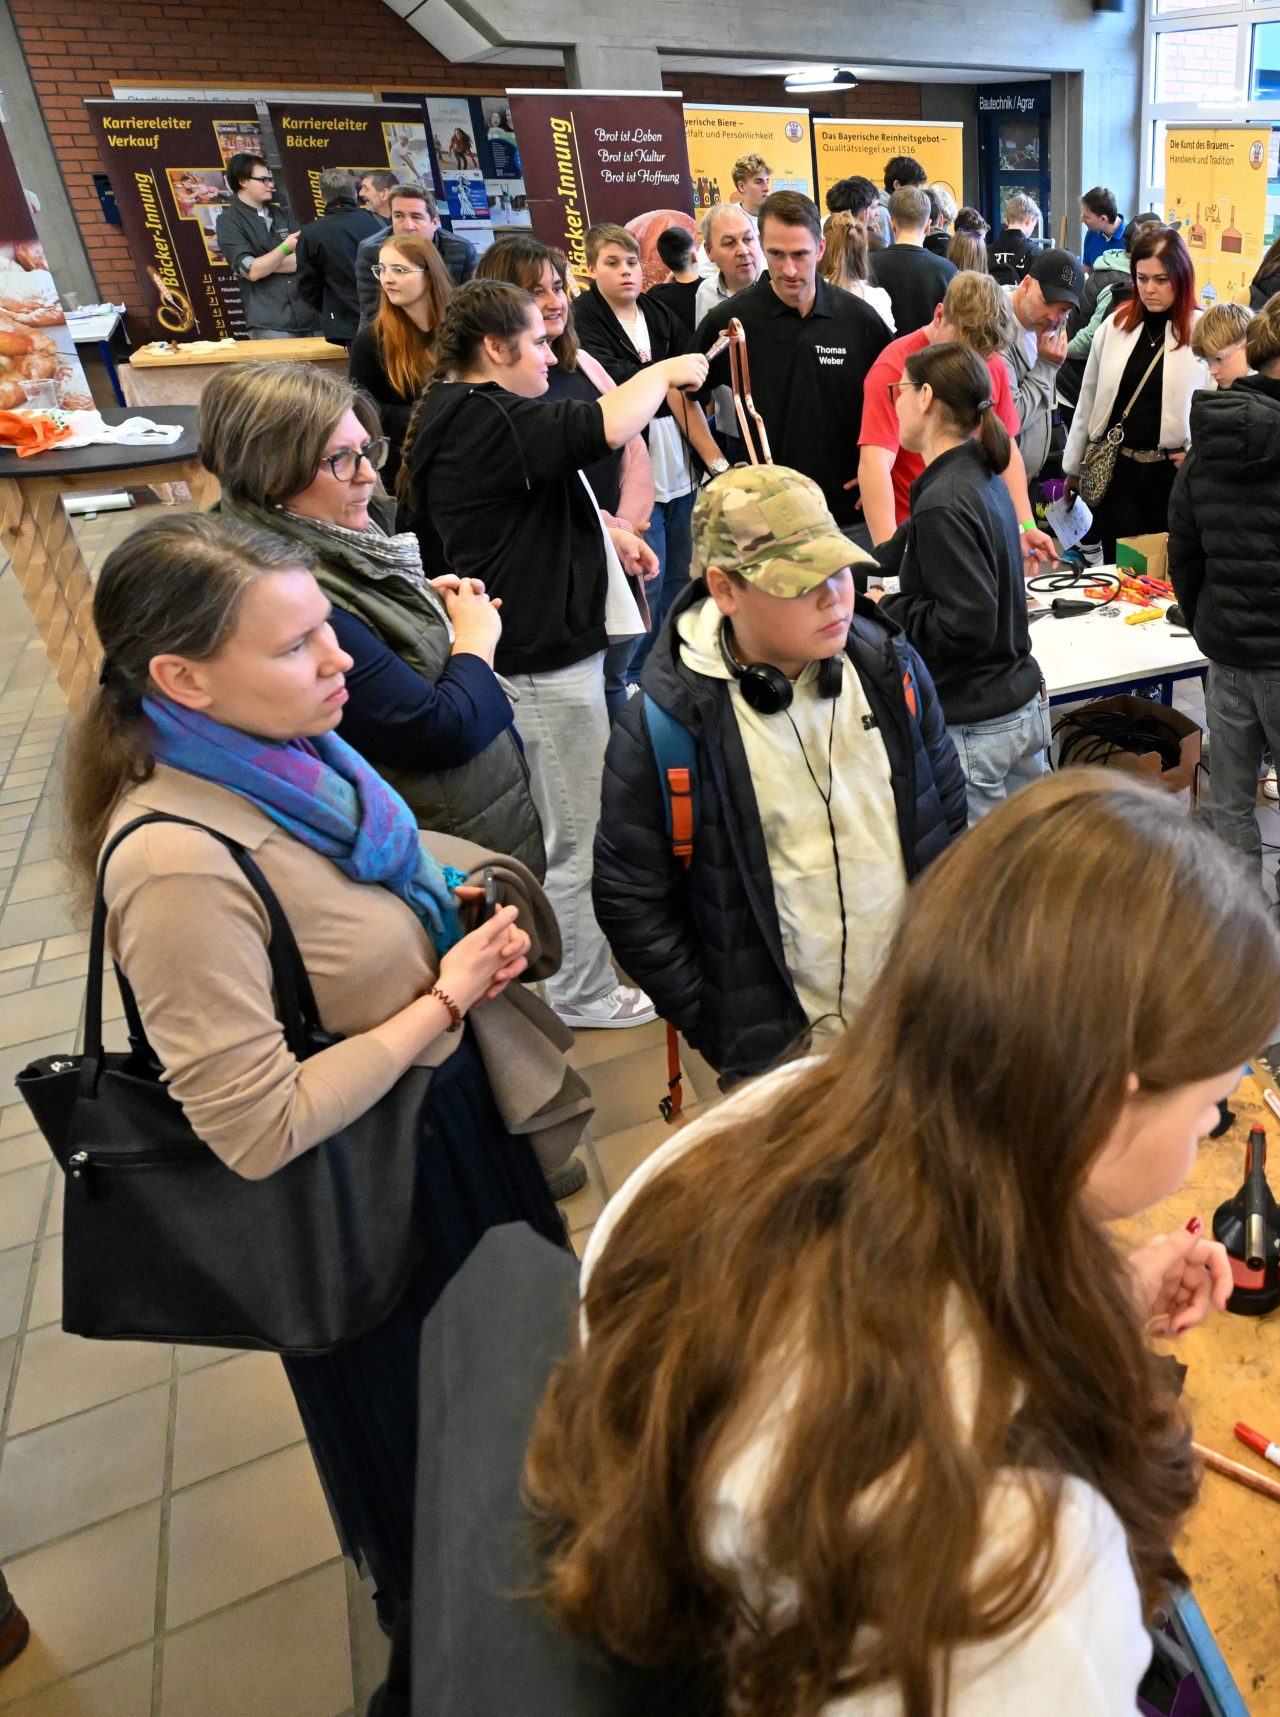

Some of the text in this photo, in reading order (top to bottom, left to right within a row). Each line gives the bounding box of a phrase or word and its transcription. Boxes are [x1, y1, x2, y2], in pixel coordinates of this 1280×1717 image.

[979, 96, 1012, 110] Bautechnik
[1017, 96, 1035, 113] Agrar
[102, 116, 192, 130] Karriereleiter
[282, 116, 368, 131] Karriereleiter
[684, 118, 716, 128] yerische
[717, 118, 737, 127] Biere
[286, 135, 330, 148] Bäcker
[594, 128, 662, 142] Brot ist Leben
[685, 129, 774, 140] lfalt und Persönlichkeit
[822, 131, 837, 140] Das
[838, 132, 880, 143] Bayerische
[881, 133, 940, 145] Reinheitsgebot
[107, 135, 160, 150] Verkauf
[822, 143, 916, 155] Qualitätssiegel seit 1516
[1170, 139, 1180, 149] Die
[1180, 140, 1195, 149] Kunst
[1195, 141, 1205, 150] des
[1206, 141, 1229, 150] Brauens
[598, 149, 665, 163] Brot ist Kultur
[1170, 155, 1234, 165] Handwerk und Tradition
[601, 169, 680, 185] Brot ist Hoffnung
[550, 117, 592, 278] Bäcker-Innung
[134, 172, 180, 288] Bäcker-Innung
[815, 345, 847, 354] Thomas
[819, 356, 845, 365] Weber
